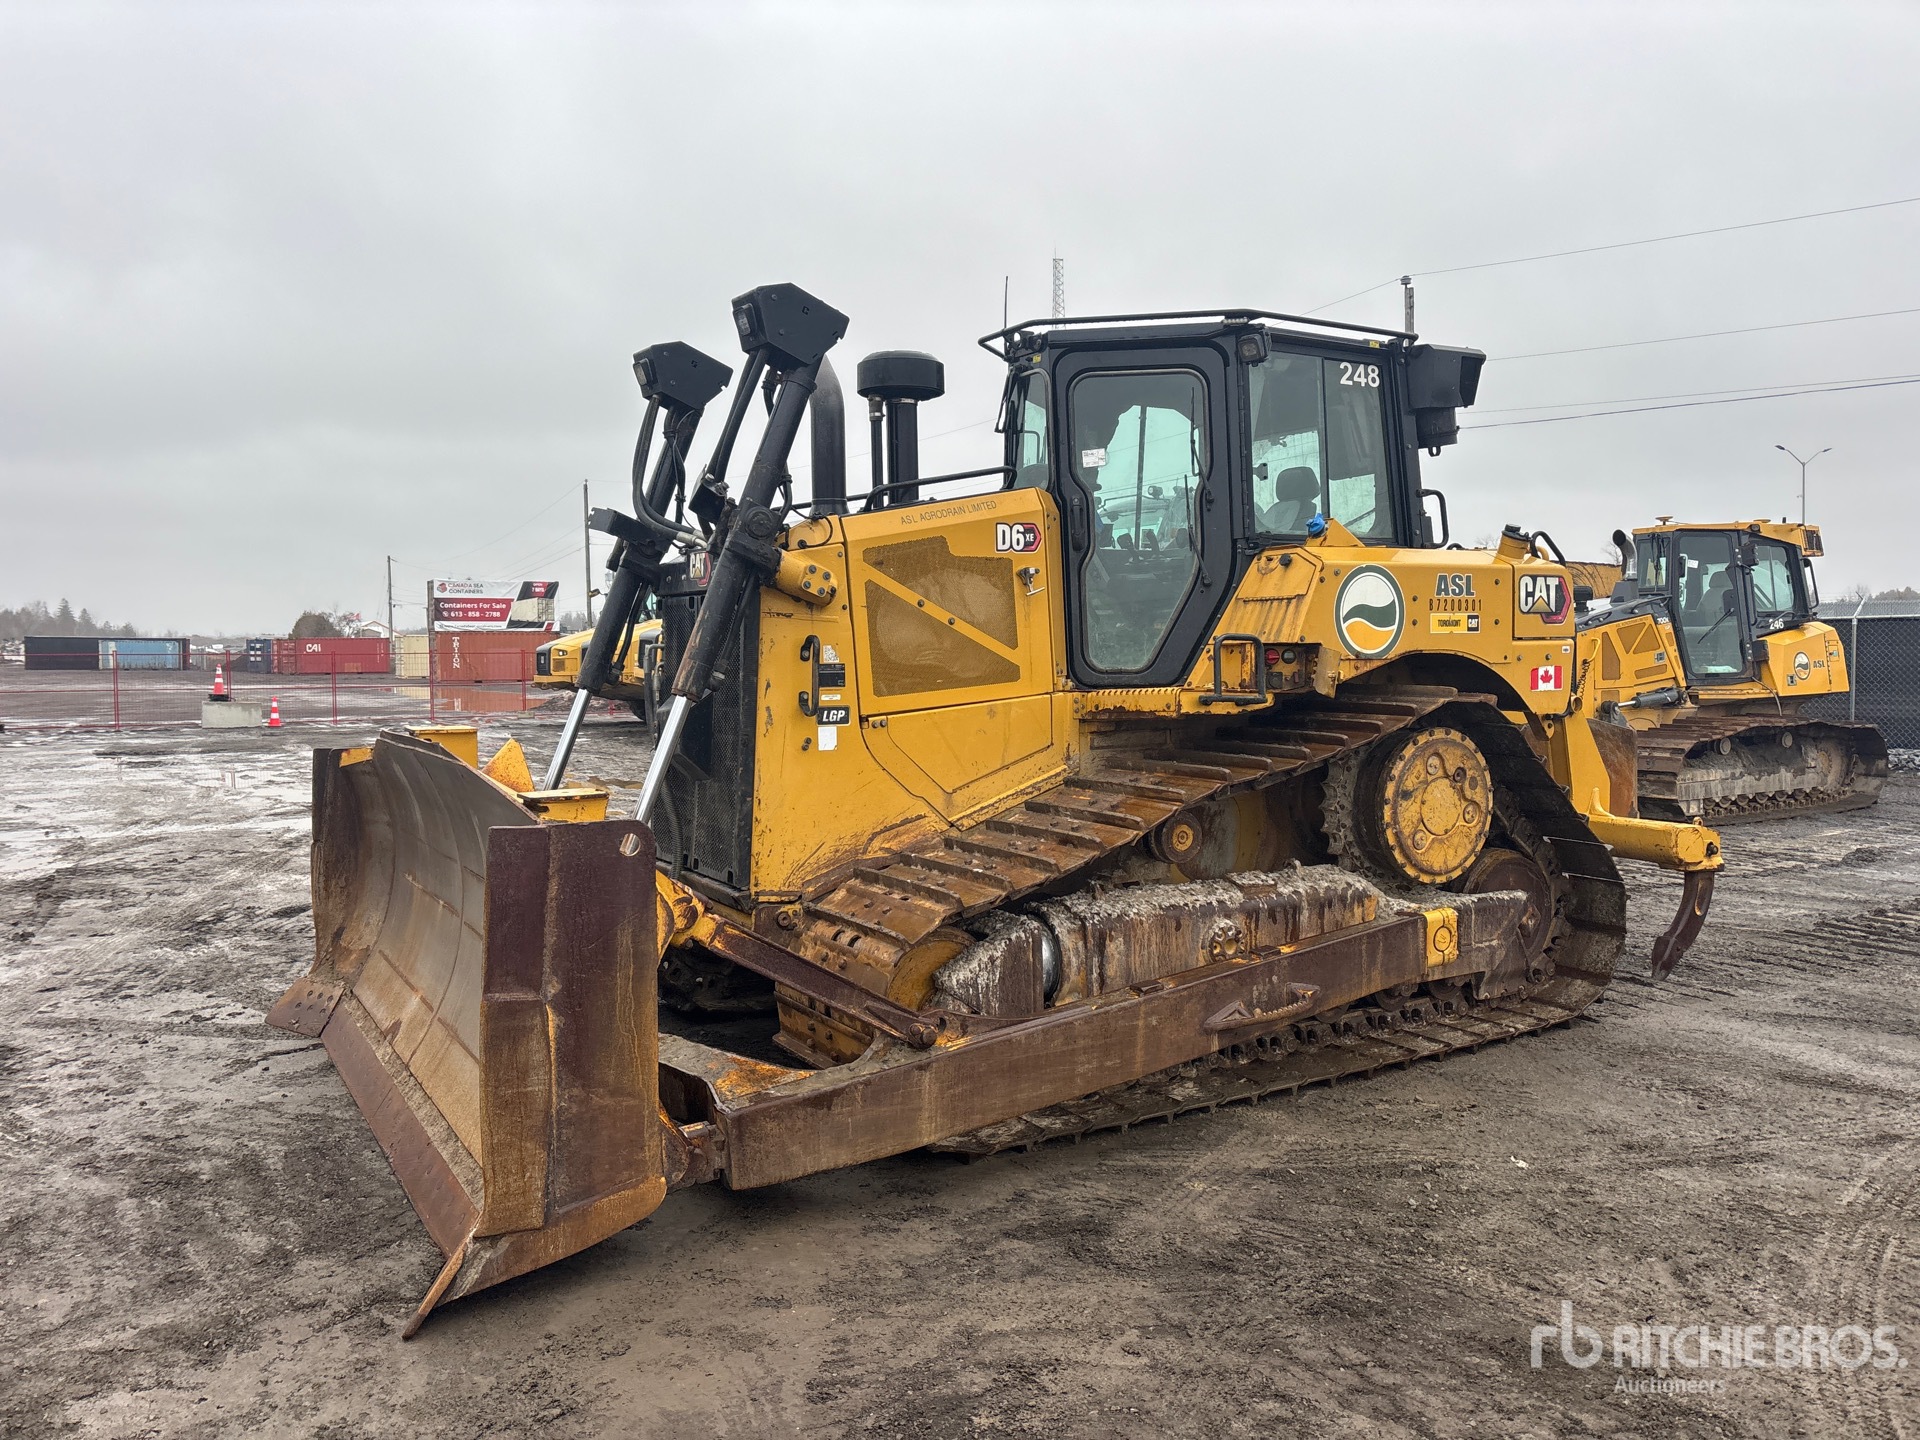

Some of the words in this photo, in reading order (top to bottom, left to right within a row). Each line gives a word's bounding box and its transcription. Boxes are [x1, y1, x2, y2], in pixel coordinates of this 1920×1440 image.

[1340, 362, 1380, 388] 248
[901, 514, 918, 525] ASL
[920, 506, 966, 521] AGRODRAIN
[968, 501, 997, 513] LIMITED
[1025, 533, 1035, 542] XE
[690, 552, 706, 579] CAT
[1435, 573, 1476, 597] ASL
[1520, 575, 1559, 612] CAT
[1429, 599, 1481, 611] B7200301
[1468, 619, 1478, 628] CAT
[1769, 619, 1784, 630] 246
[306, 643, 321, 652] CAI
[452, 636, 461, 669] TRITON
[1813, 660, 1825, 669] ASL
[822, 709, 846, 722] LGP
